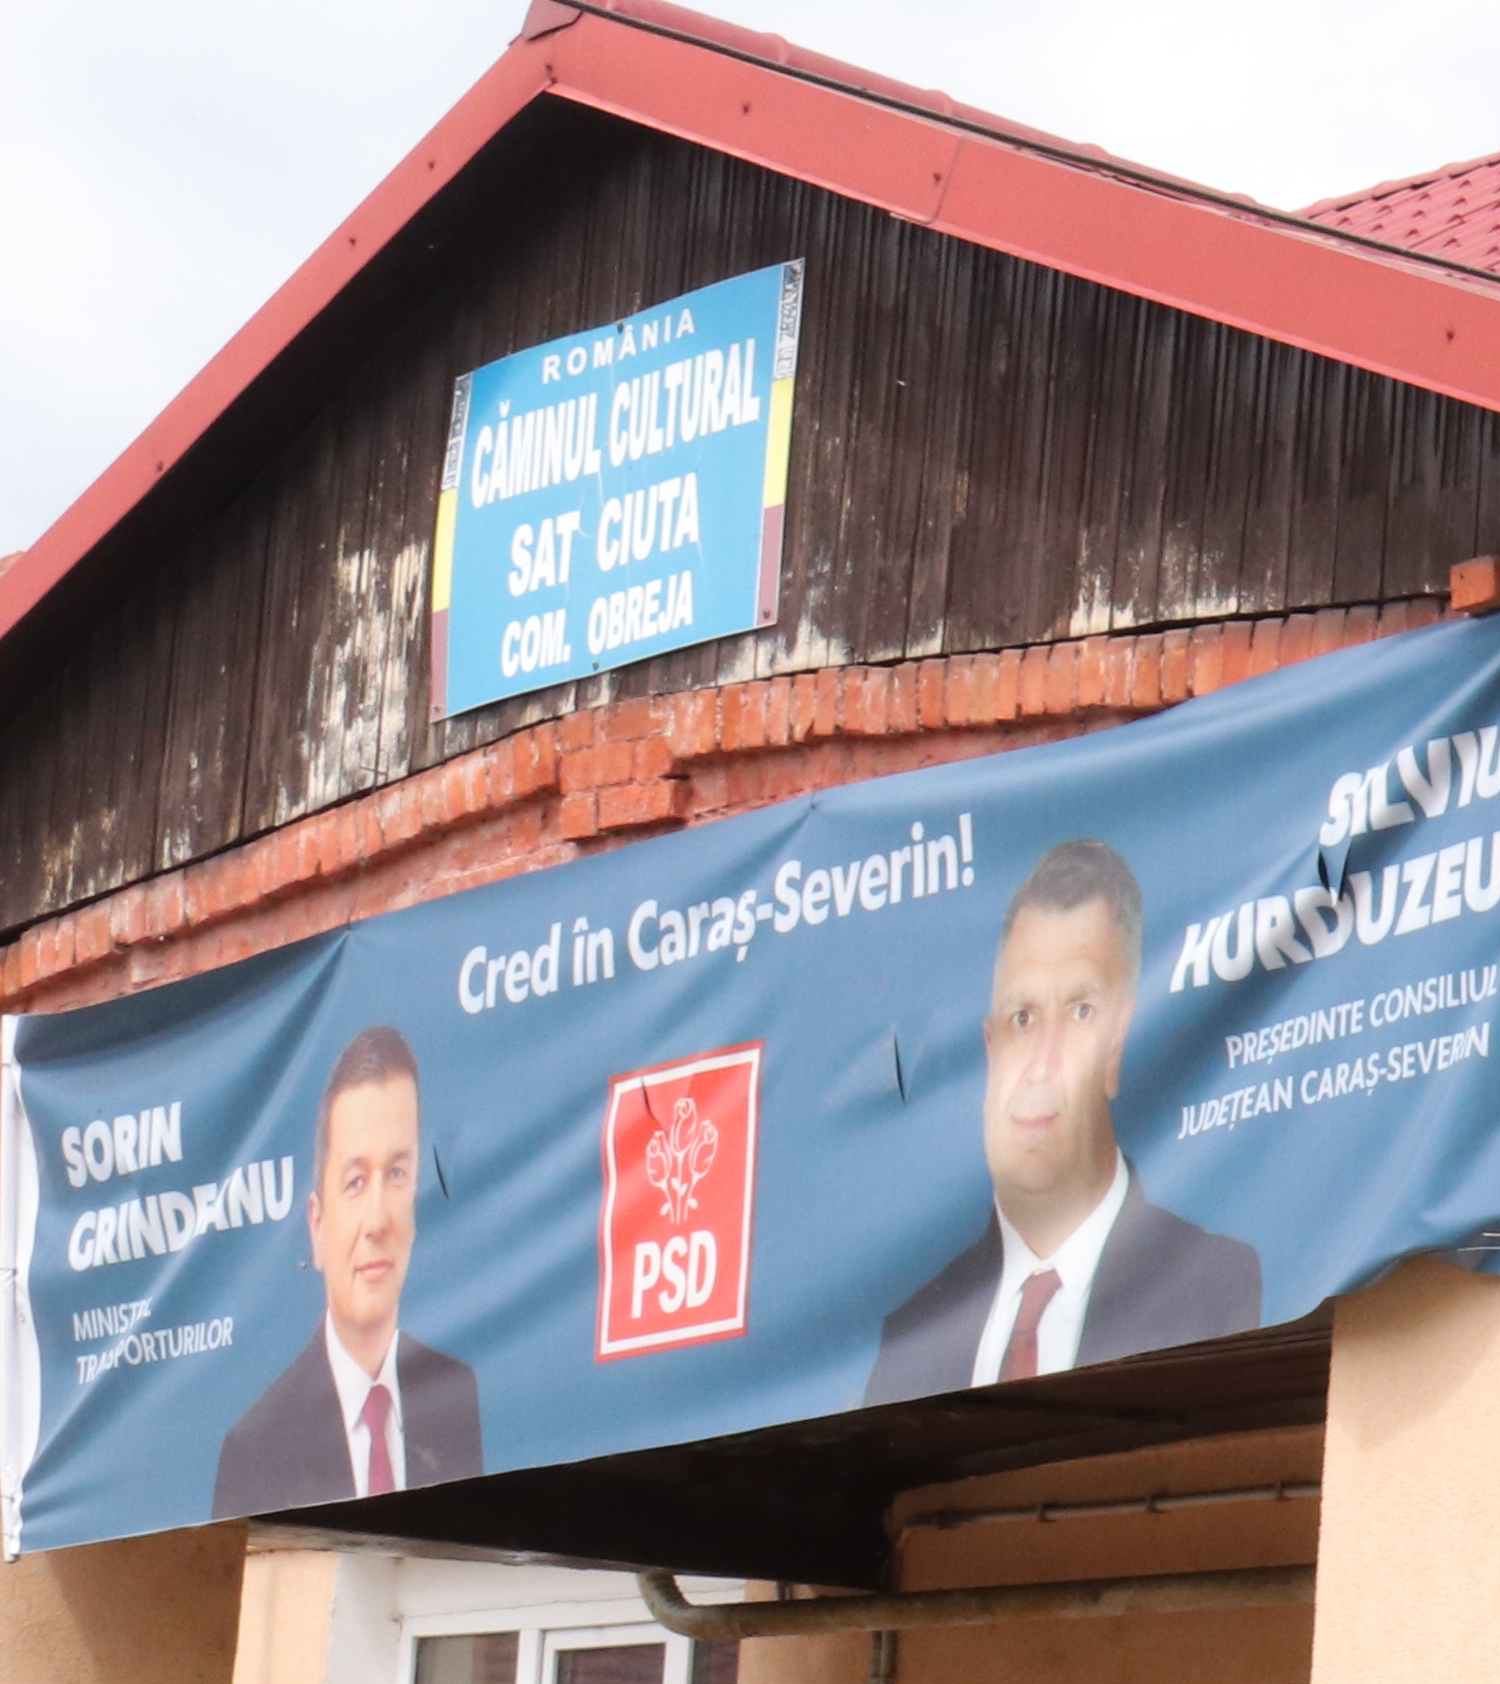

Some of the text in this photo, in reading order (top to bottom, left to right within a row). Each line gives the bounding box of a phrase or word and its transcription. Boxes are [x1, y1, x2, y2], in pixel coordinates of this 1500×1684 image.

[542, 308, 696, 384] ROMÂNIA
[470, 338, 761, 508] CĂMINUL CULTURAL
[507, 472, 698, 597] SAT CIUTA
[501, 570, 693, 678] COM. OBREJA
[458, 812, 975, 1015] Cred în Caraș-Severin!
[1225, 965, 1497, 1069] PREȘEDINTE CONSILIUL
[61, 1101, 182, 1189] SORIN
[67, 1155, 295, 1271] GRINDEANU
[631, 1229, 717, 1319] PSD
